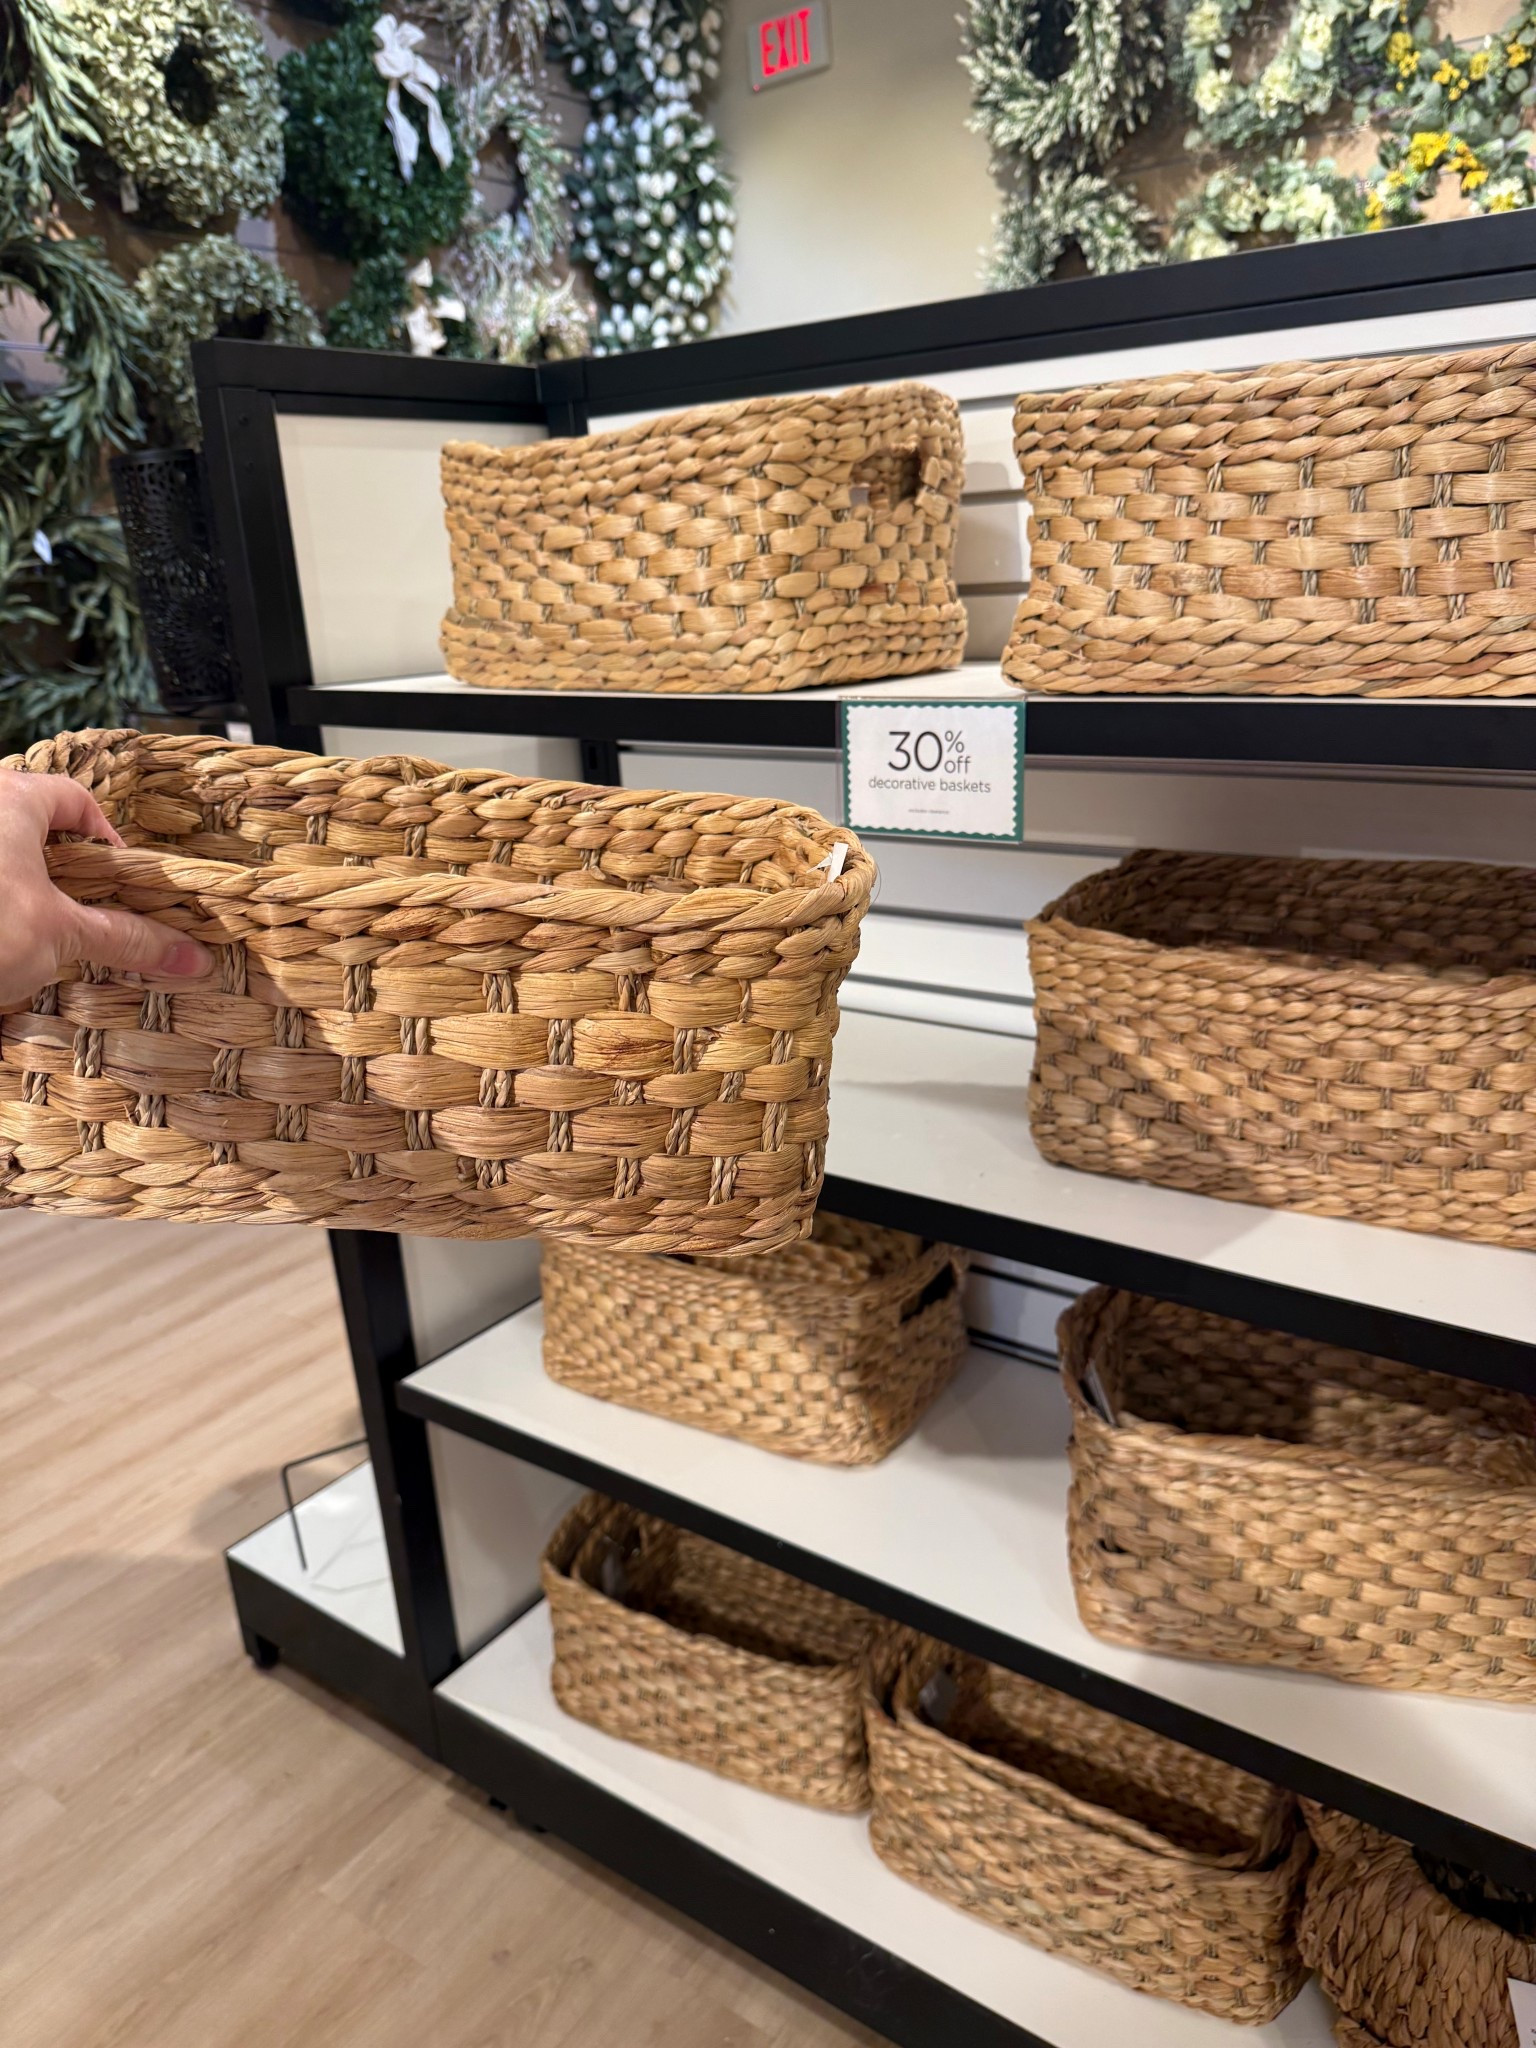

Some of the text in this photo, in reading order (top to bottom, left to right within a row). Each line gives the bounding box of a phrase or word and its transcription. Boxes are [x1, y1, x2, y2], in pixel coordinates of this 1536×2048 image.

[760, 8, 811, 77] EXIT
[944, 755, 972, 774] off
[868, 777, 991, 793] decorative baskets
